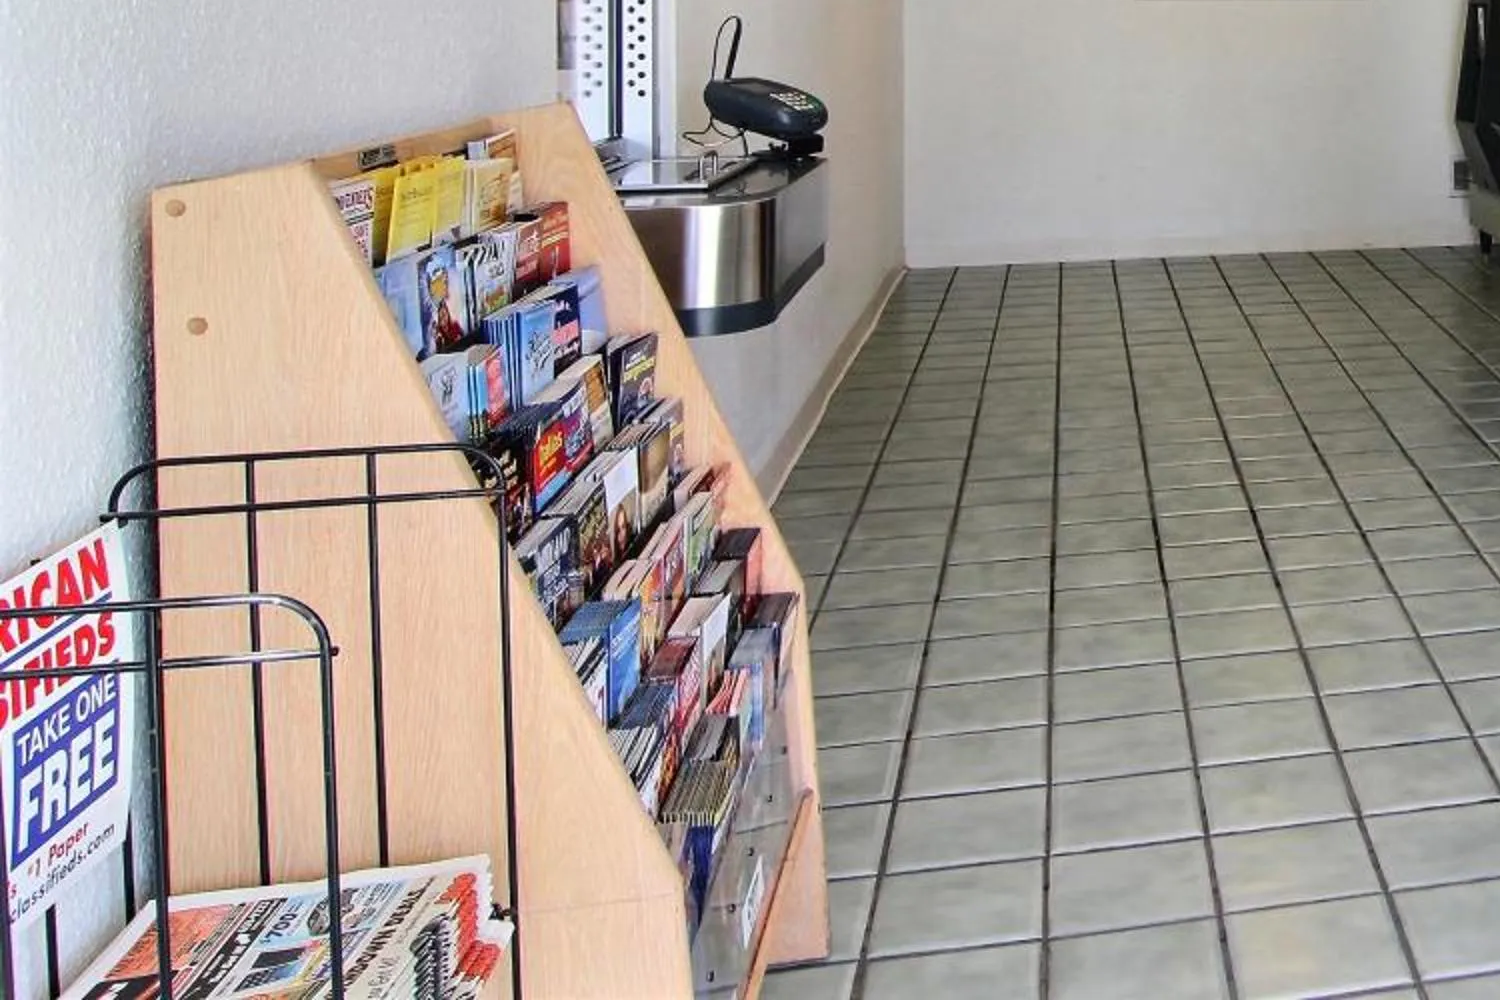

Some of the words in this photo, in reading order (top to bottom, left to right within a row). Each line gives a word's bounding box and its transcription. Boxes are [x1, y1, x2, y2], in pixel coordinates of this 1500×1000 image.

[17, 702, 70, 767] TAKE
[75, 676, 117, 722] ONE
[19, 708, 116, 852] FREE
[48, 822, 89, 867] Paper
